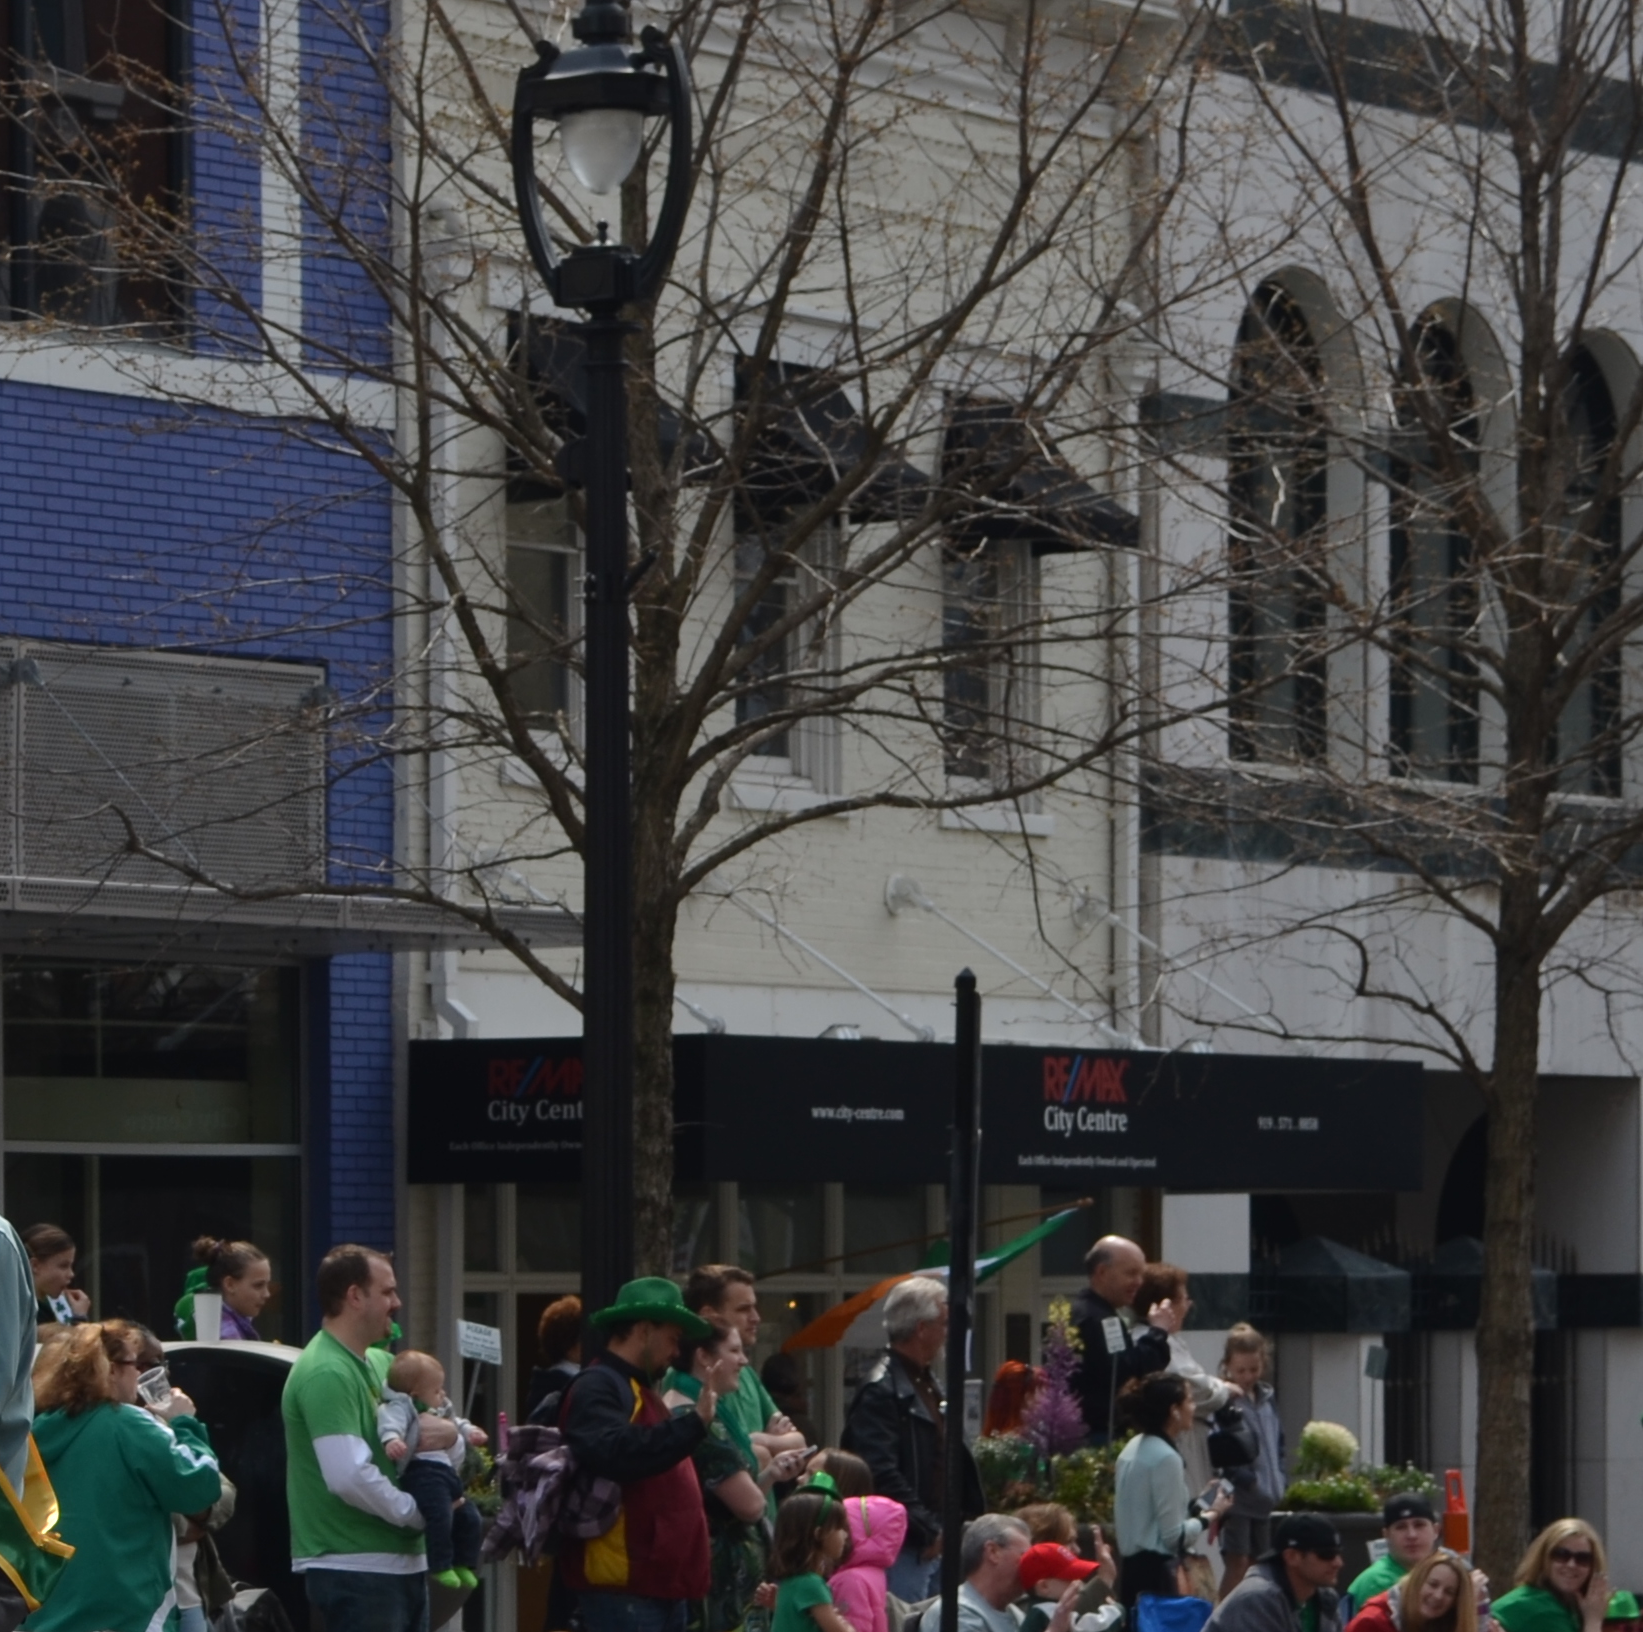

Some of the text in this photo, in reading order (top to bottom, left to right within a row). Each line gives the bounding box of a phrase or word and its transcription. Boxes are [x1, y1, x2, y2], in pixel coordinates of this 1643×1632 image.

[1043, 1053, 1130, 1104] RE/MAX
[487, 1099, 530, 1126] City
[1044, 1105, 1129, 1138] City Centre
